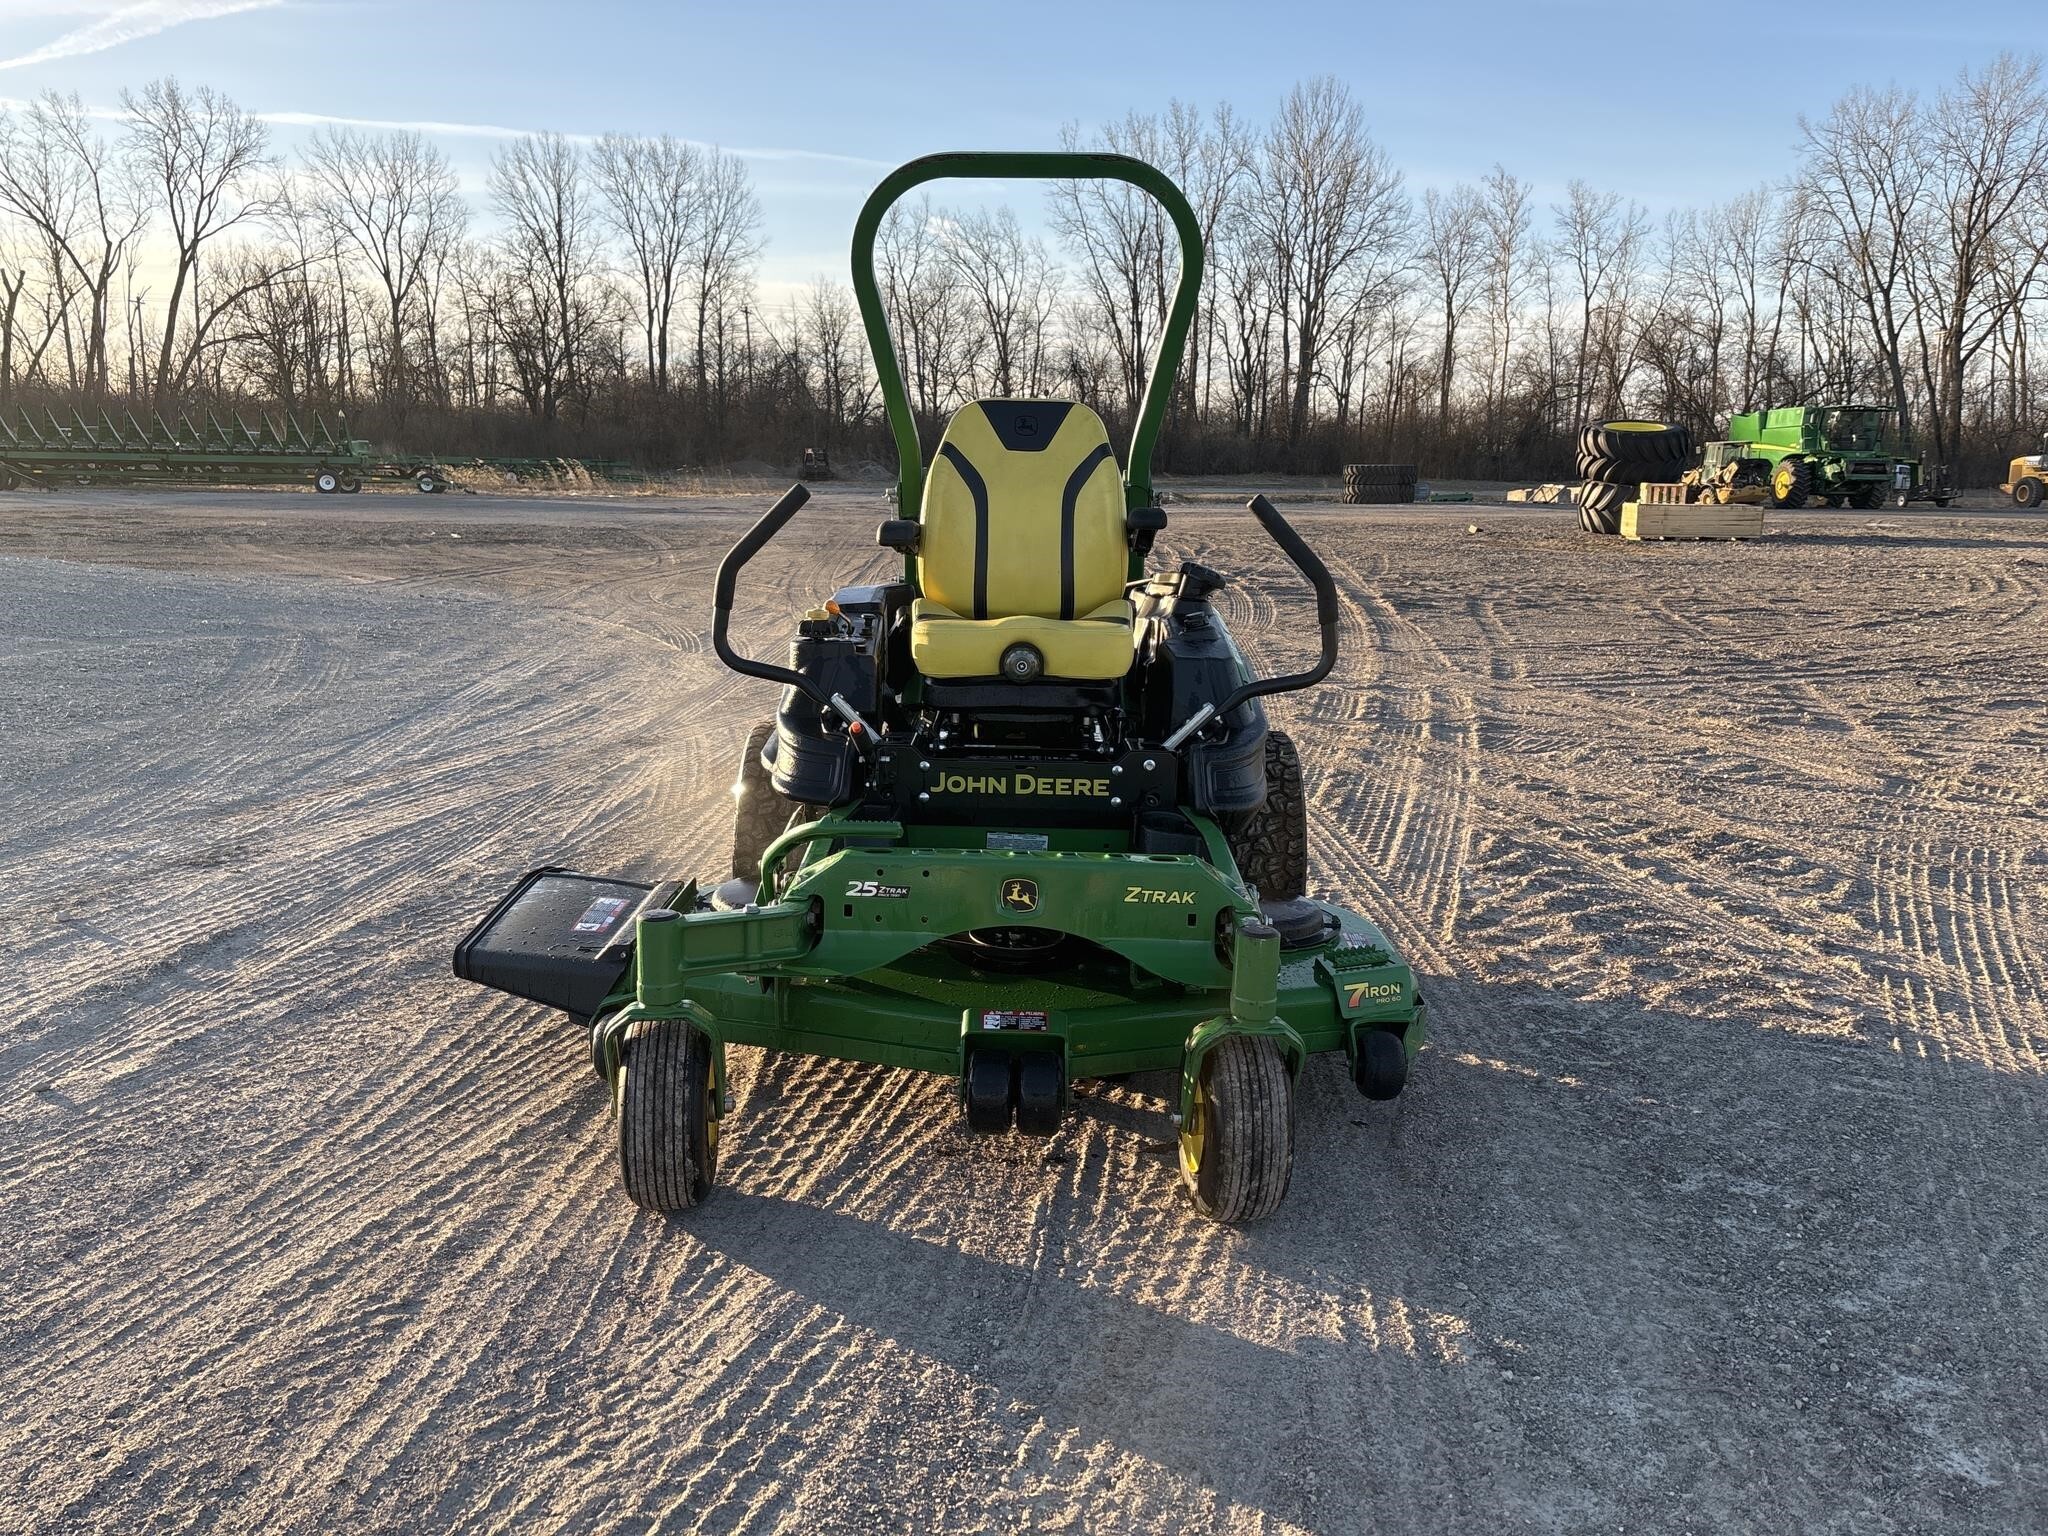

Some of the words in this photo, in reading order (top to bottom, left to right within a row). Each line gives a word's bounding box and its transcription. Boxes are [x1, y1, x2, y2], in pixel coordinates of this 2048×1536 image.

[930, 771, 1007, 794] JOHN
[1015, 773, 1110, 796] DEERE
[845, 880, 879, 897] 25
[878, 886, 908, 894] ZTRAK
[1123, 886, 1197, 904] ZTRAK
